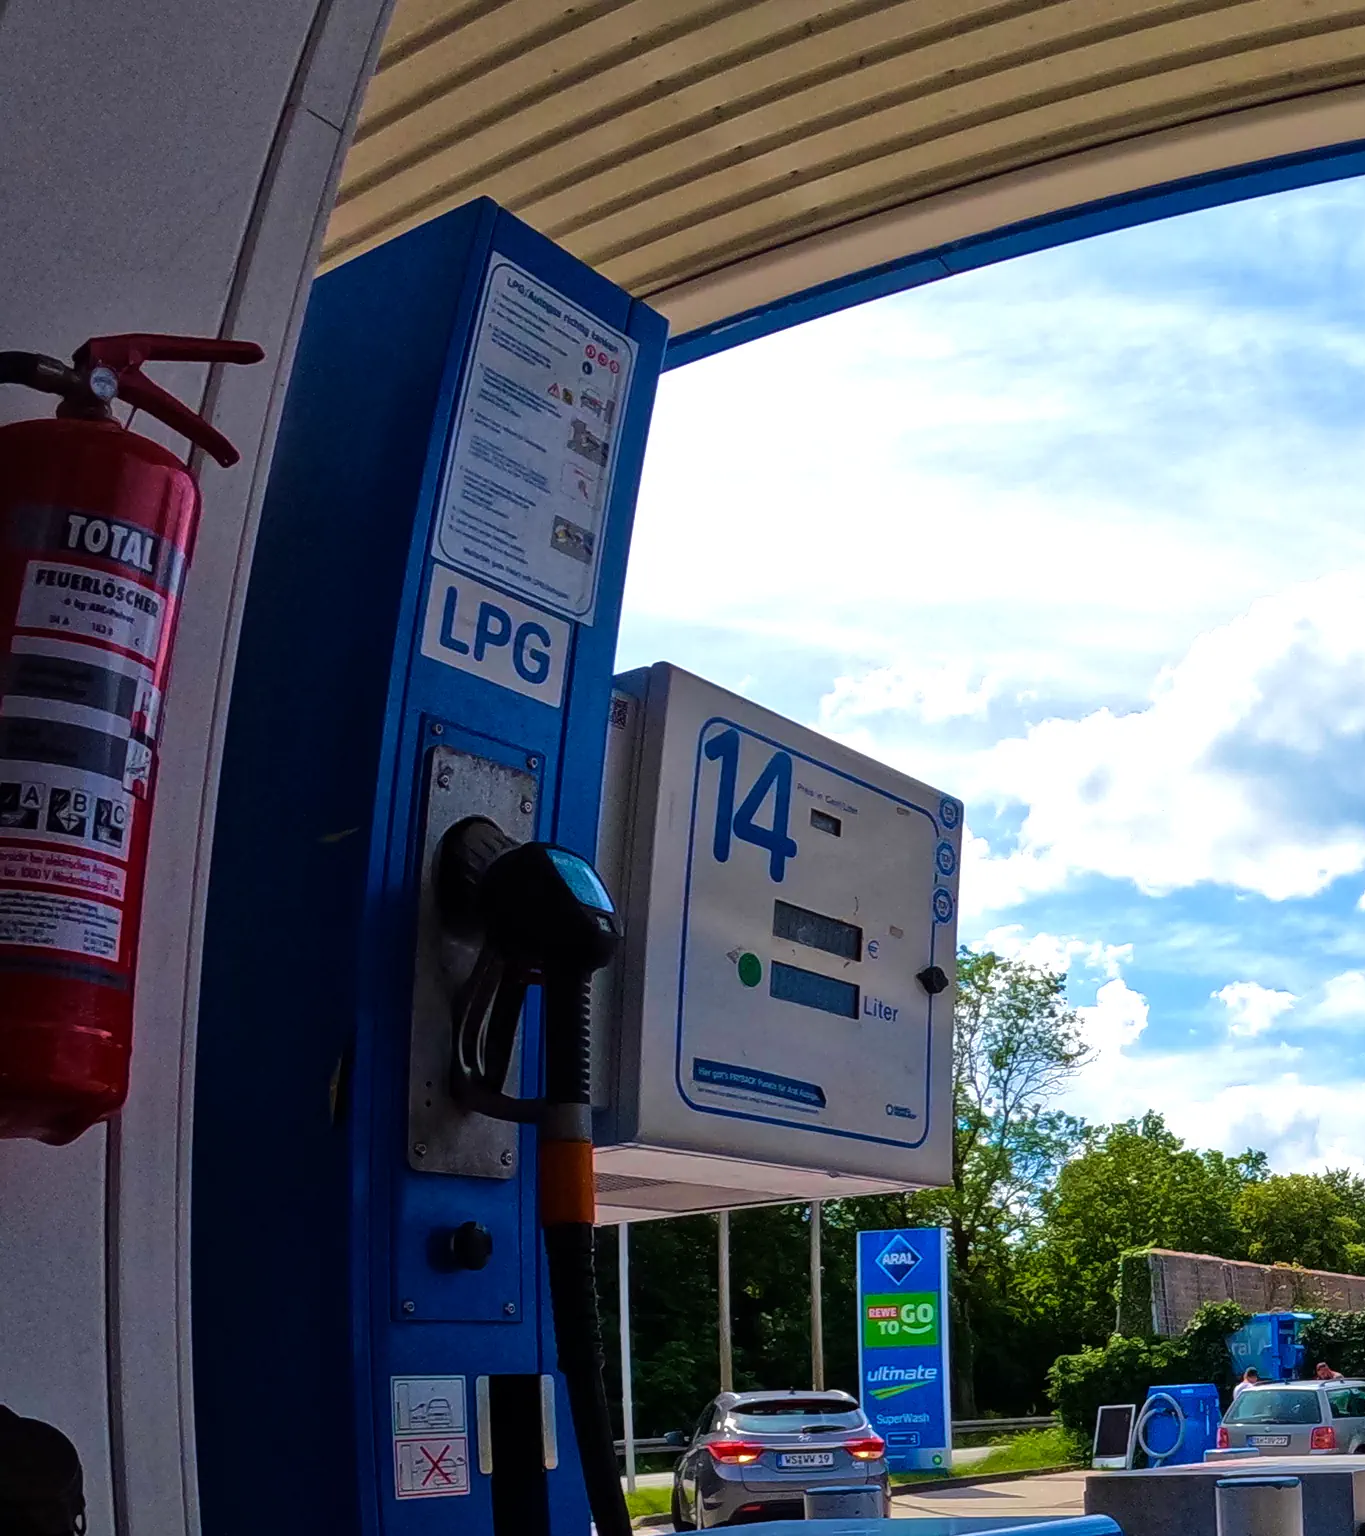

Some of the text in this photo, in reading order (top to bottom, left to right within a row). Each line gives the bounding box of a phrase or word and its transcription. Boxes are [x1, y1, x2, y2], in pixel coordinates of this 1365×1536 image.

[68, 514, 154, 572] TOTAL
[35, 569, 158, 617] FEUERLÖSCHER
[438, 585, 552, 685] LPG
[23, 785, 125, 825] A B C
[704, 728, 797, 883] 14
[867, 940, 880, 960] €
[863, 995, 899, 1023] Liter
[882, 1252, 916, 1266] ARAL
[868, 1303, 934, 1323] REWE GO
[877, 1321, 899, 1335] TO
[867, 1365, 937, 1382] ultimate
[876, 1413, 930, 1426] SuperWash
